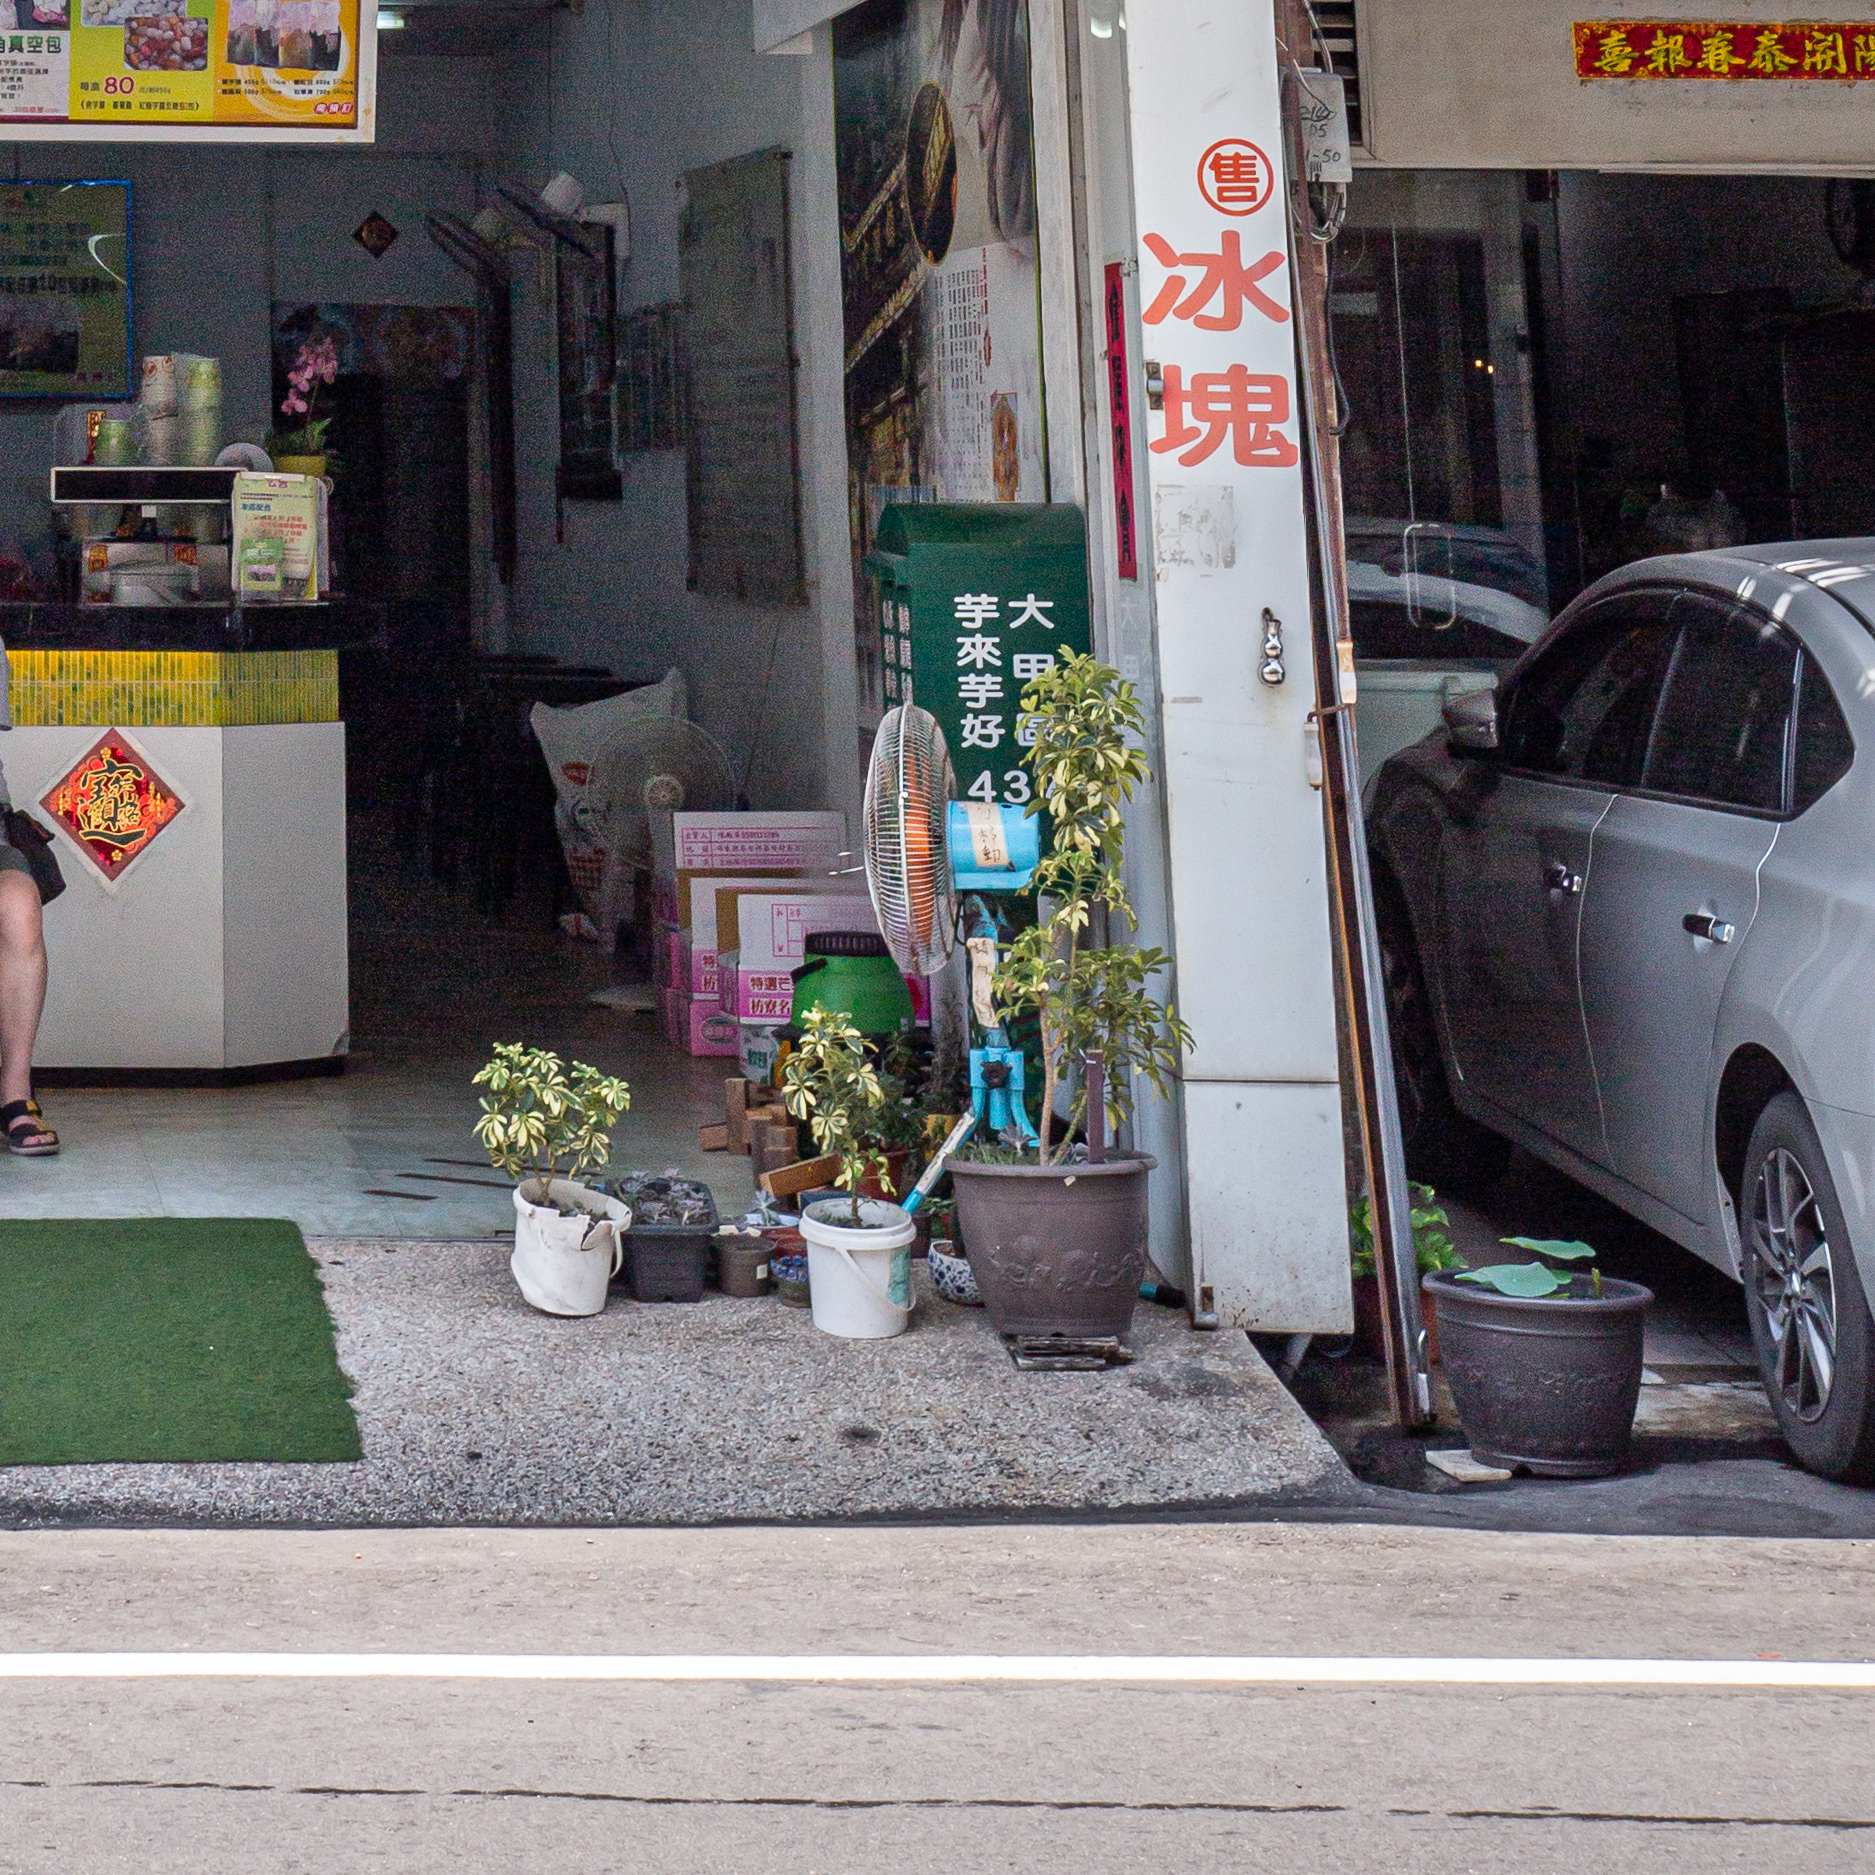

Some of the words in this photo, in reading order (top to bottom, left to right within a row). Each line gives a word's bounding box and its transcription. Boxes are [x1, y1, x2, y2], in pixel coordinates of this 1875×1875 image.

[104, 75, 135, 95] 80
[1203, 149, 1266, 203] 售
[1141, 229, 1299, 469] 冰塊
[954, 593, 1006, 749] 芋來芋好
[968, 770, 1056, 804] 43
[749, 976, 794, 992] 特選芒
